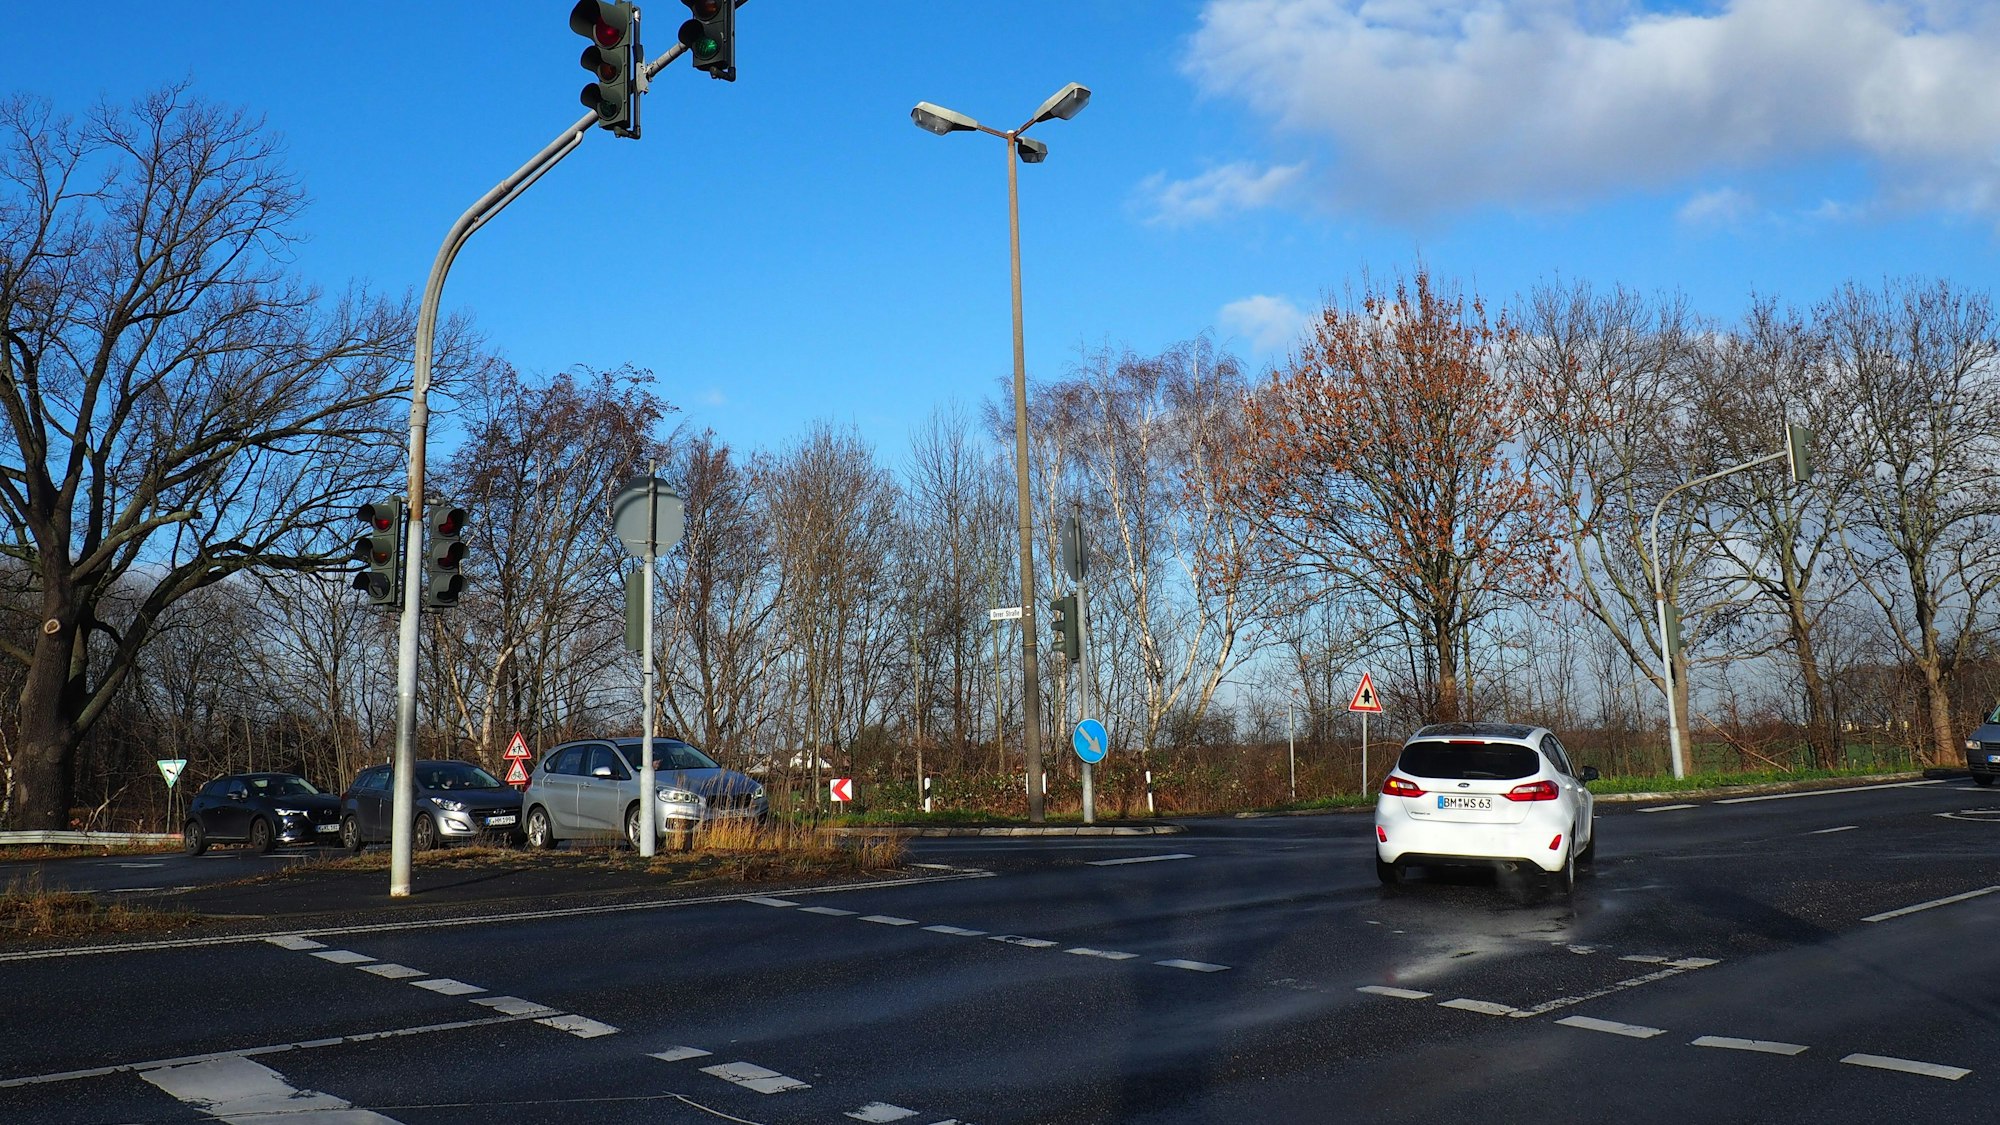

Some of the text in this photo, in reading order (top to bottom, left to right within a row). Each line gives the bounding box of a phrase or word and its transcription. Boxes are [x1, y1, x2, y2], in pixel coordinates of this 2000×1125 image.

[1006, 609, 1020, 617] Straße
[1443, 797, 1491, 809] BM WS 63
